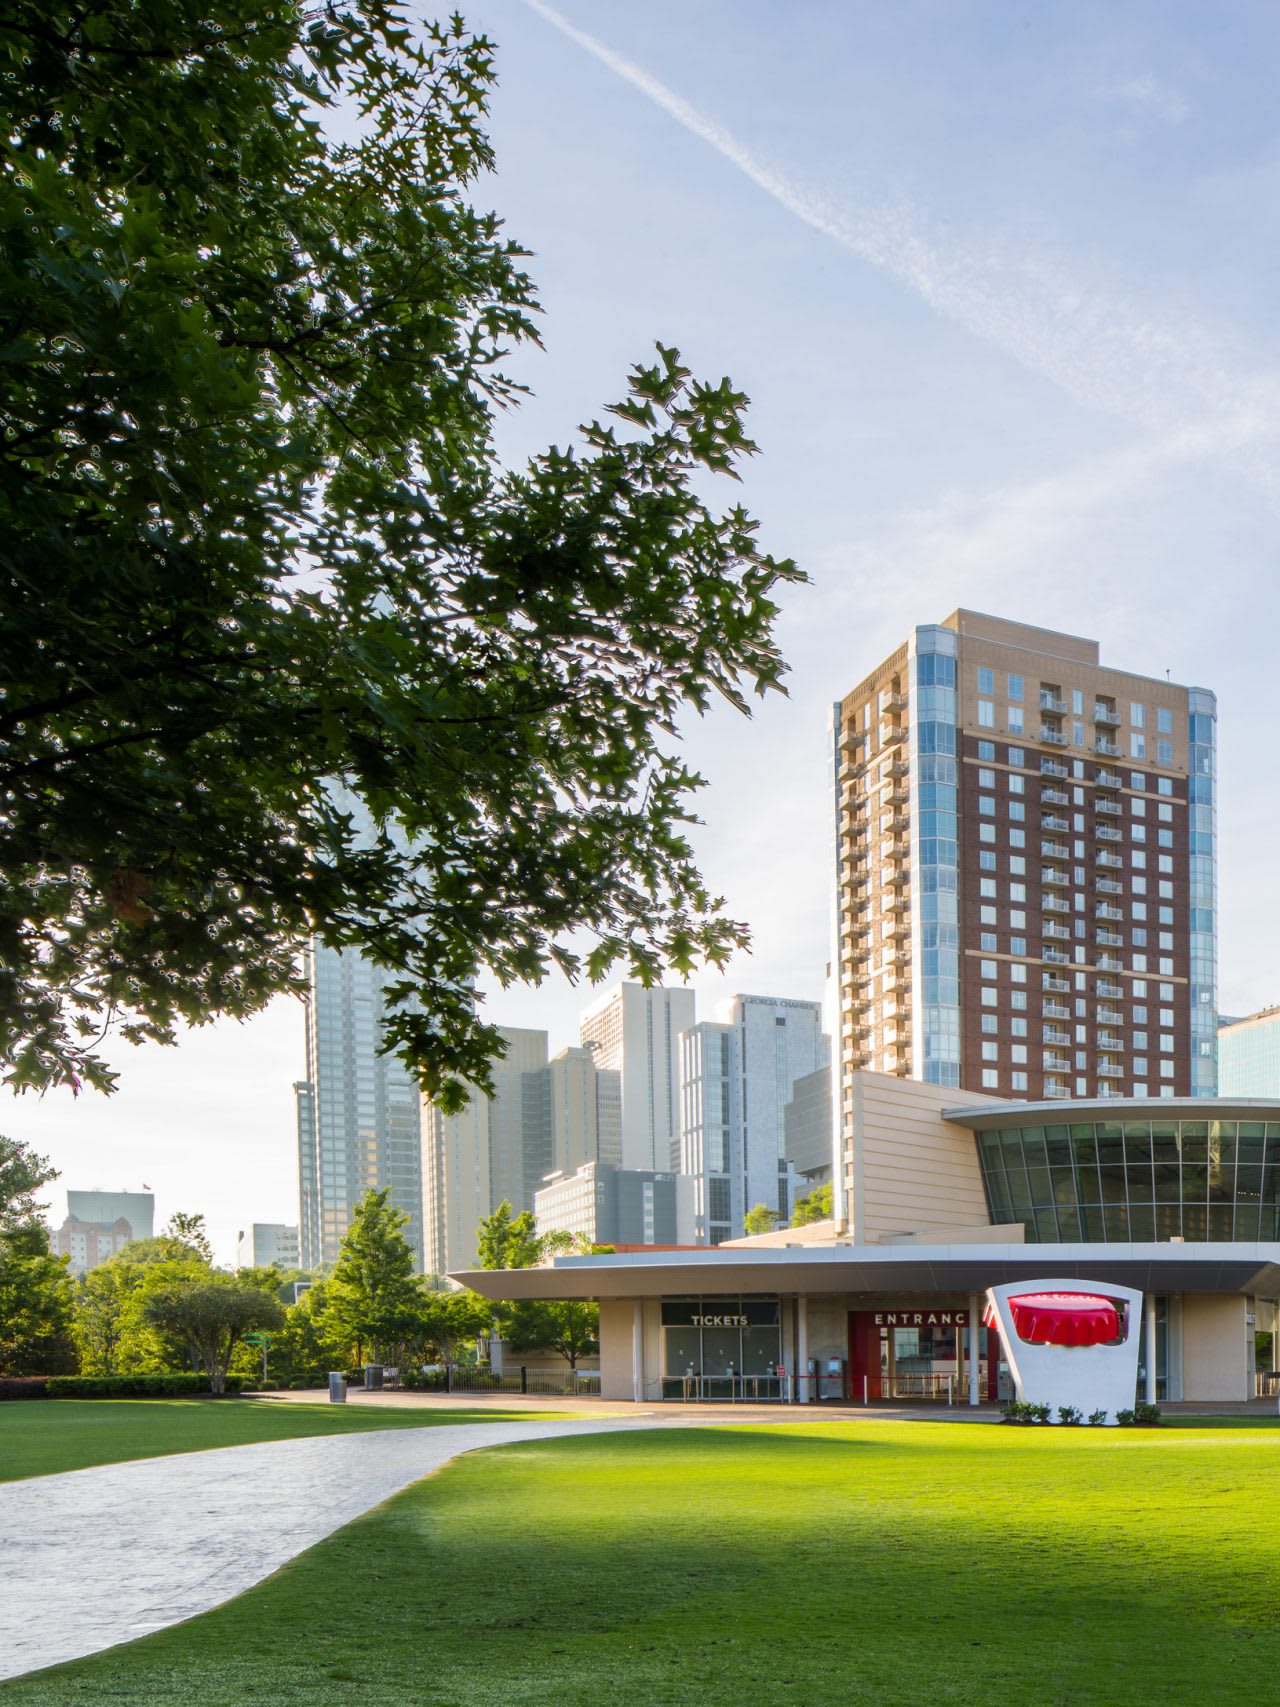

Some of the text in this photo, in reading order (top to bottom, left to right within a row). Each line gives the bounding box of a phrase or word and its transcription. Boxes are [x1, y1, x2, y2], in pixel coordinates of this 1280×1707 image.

[745, 996, 777, 1006] GEORGIA
[691, 1315, 749, 1326] TICKETS
[874, 1313, 965, 1325] ENTRANC
